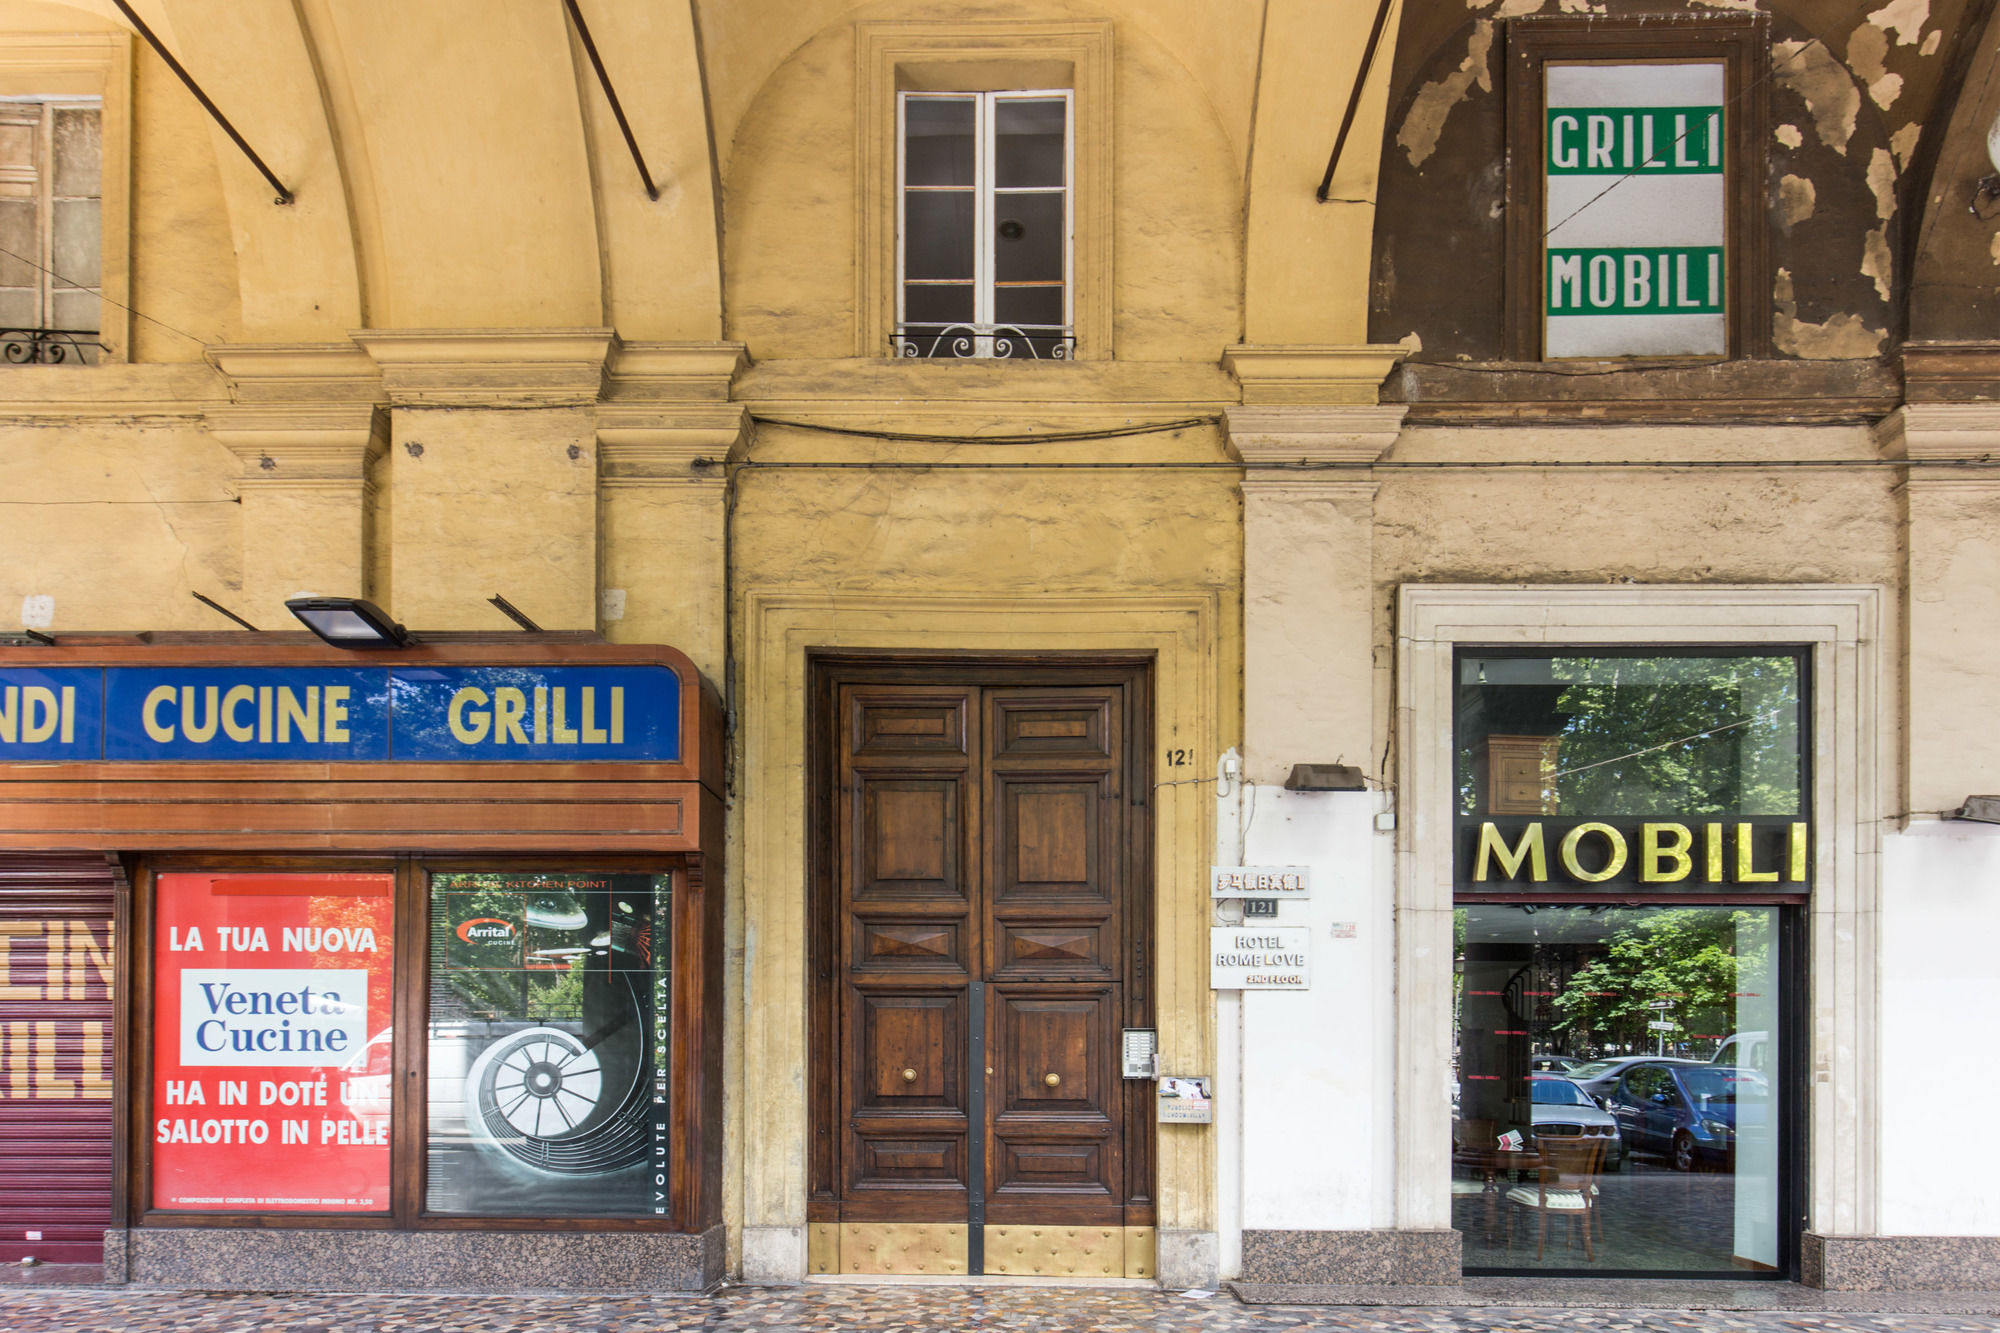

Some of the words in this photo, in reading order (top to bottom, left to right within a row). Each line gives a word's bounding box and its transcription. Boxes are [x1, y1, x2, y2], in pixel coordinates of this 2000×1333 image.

[1552, 113, 1719, 168] GRILLI
[1551, 253, 1719, 308] MOBILI
[142, 685, 350, 743] CUCINE
[448, 686, 624, 744] GRILLI
[1474, 821, 1807, 883] MOBILI
[506, 880, 563, 889] KITCHEN
[567, 880, 607, 889] POINT
[1251, 902, 1274, 913] 121
[170, 926, 204, 952] LA
[217, 926, 269, 952] TUA
[282, 926, 378, 953] NUOVA
[467, 926, 509, 938] Arrital
[1235, 936, 1284, 949] HOTEL
[1216, 953, 1261, 967] ROME
[1265, 953, 1304, 966] LOVE
[1247, 975, 1267, 984] 2ND
[1269, 975, 1302, 984] FLOOR
[199, 983, 346, 1015] Veneta
[655, 977, 668, 1054] SCELTA
[195, 1020, 348, 1053] Cucine
[166, 1081, 206, 1106] HA
[219, 1081, 248, 1106] IN
[655, 1060, 667, 1104] PER
[157, 1119, 269, 1144] SALOTTO
[282, 1119, 309, 1144] IN
[321, 1119, 389, 1145] PELLE
[655, 1122, 666, 1214] EVOLUTE
